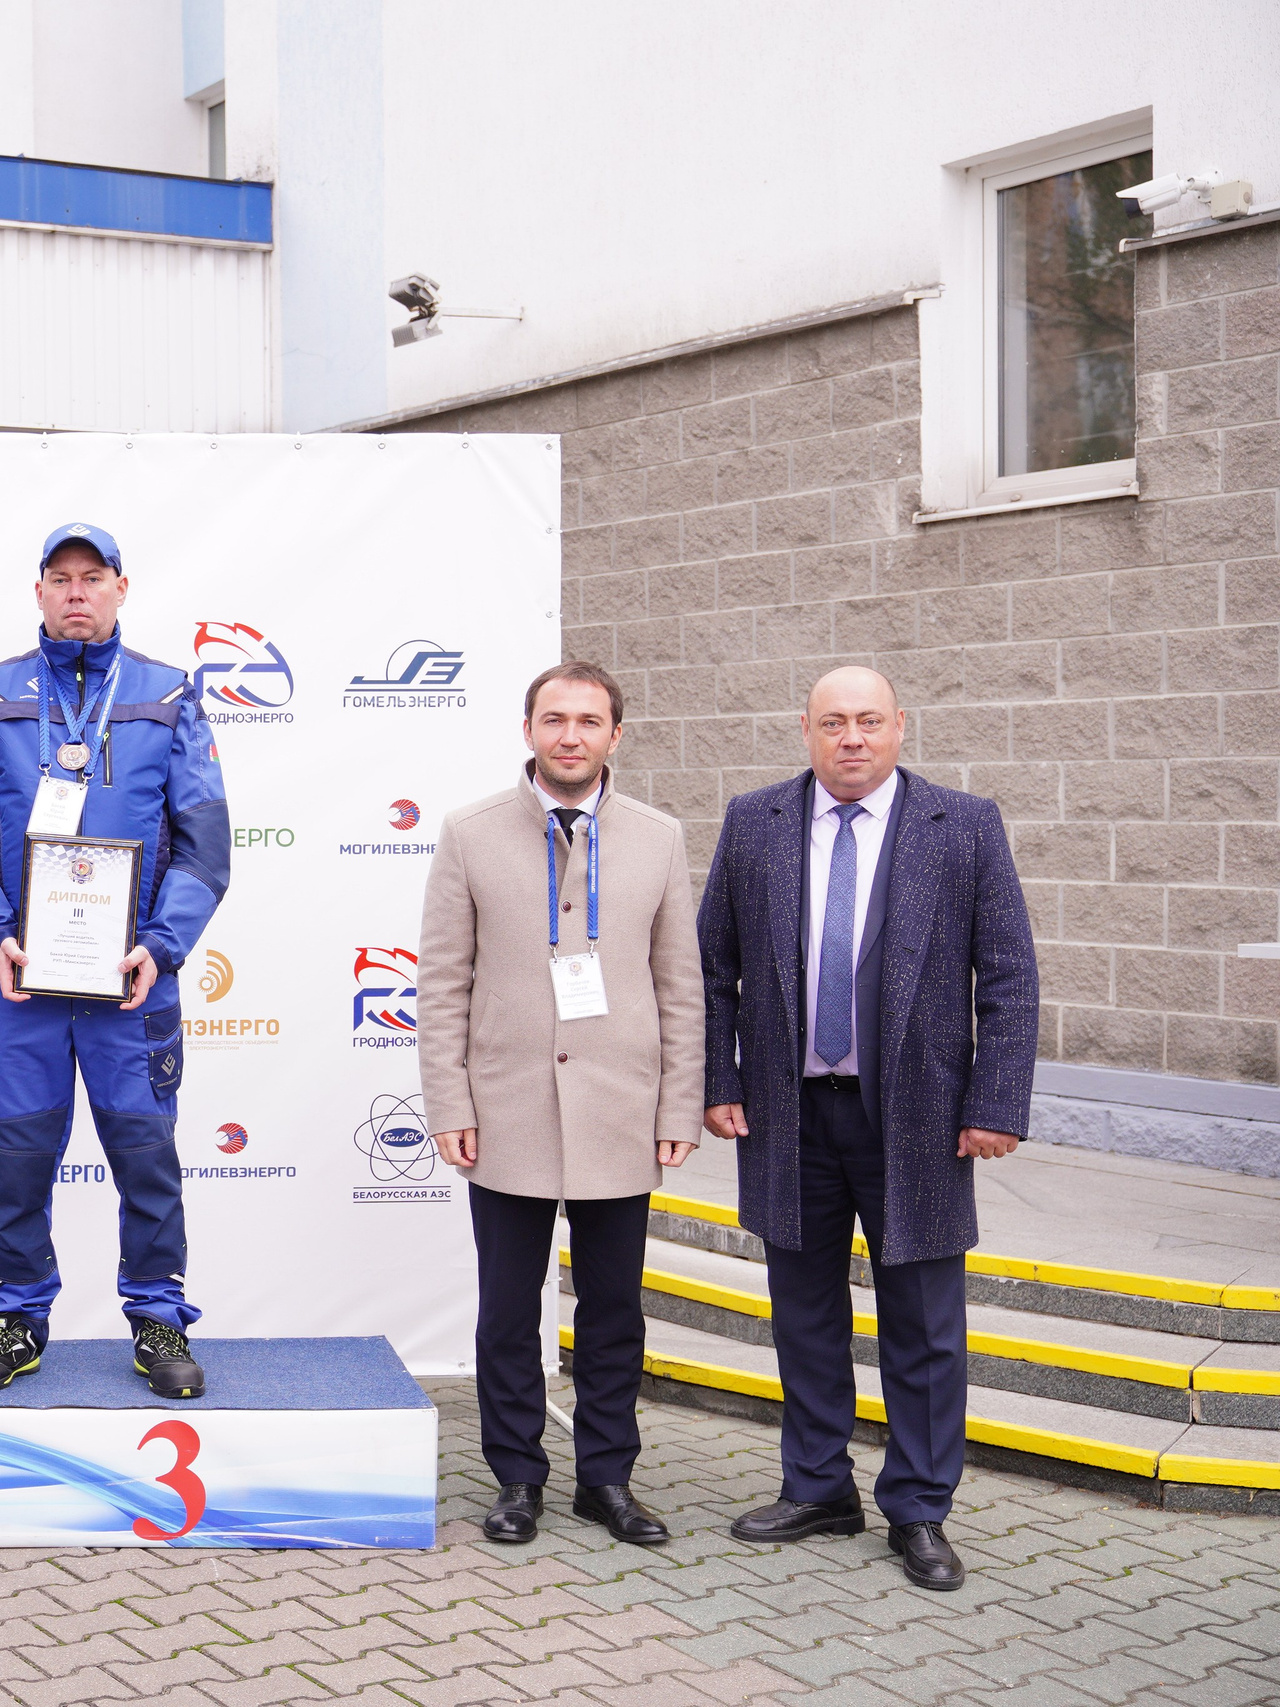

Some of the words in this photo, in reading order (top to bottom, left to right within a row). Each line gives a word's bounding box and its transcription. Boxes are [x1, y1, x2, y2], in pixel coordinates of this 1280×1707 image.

[342, 695, 467, 708] ГОМЕЛЬЭНЕРГО
[207, 713, 294, 725] ОДНОЭНЕРГО
[339, 843, 437, 855] МОГИЛЕВЭНЕ
[47, 890, 112, 906] ДИПЛОМ
[181, 1019, 280, 1036] ЛЭНЕРГО
[352, 1036, 417, 1049] ГРОДНОЭН
[383, 1130, 423, 1143] БелАЭС
[180, 1166, 297, 1179] ОГИЛЕВЭНЕРГО
[352, 1190, 427, 1199] БЕЛОРУССКАЯ
[430, 1190, 452, 1199] АЭС
[132, 1419, 206, 1540] 3
